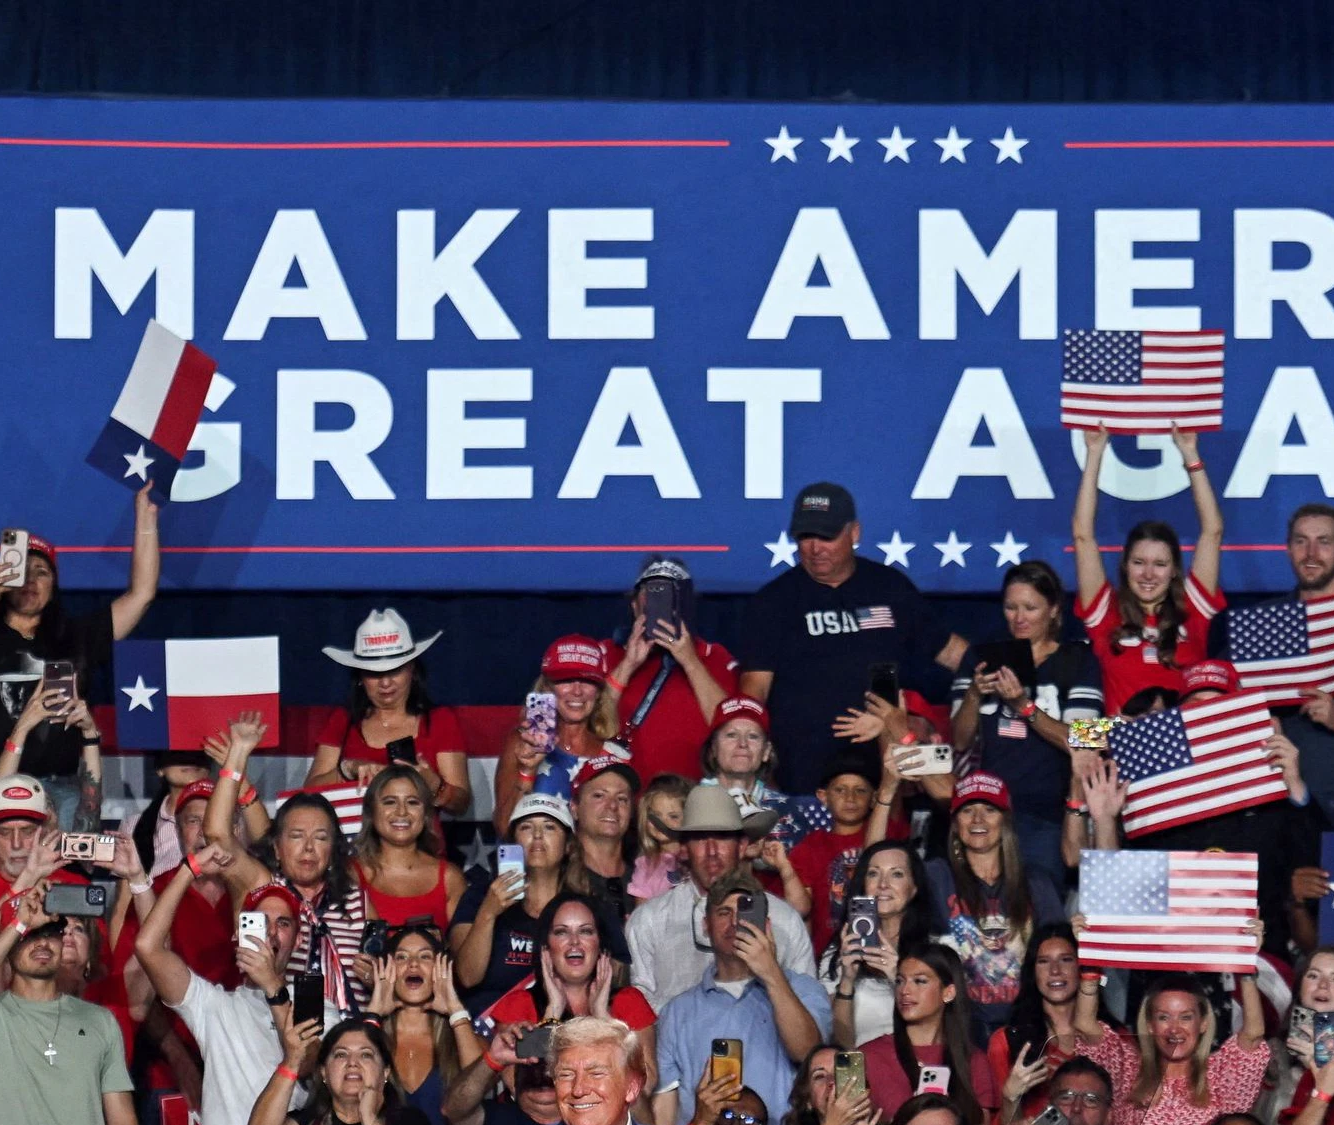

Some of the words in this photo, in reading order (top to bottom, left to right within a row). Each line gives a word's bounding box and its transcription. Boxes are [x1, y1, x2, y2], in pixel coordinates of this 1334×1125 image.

[53, 209, 655, 341] MAKE
[171, 366, 822, 501] GREAT
[363, 635, 400, 647] TRUMP
[805, 611, 859, 636] USA
